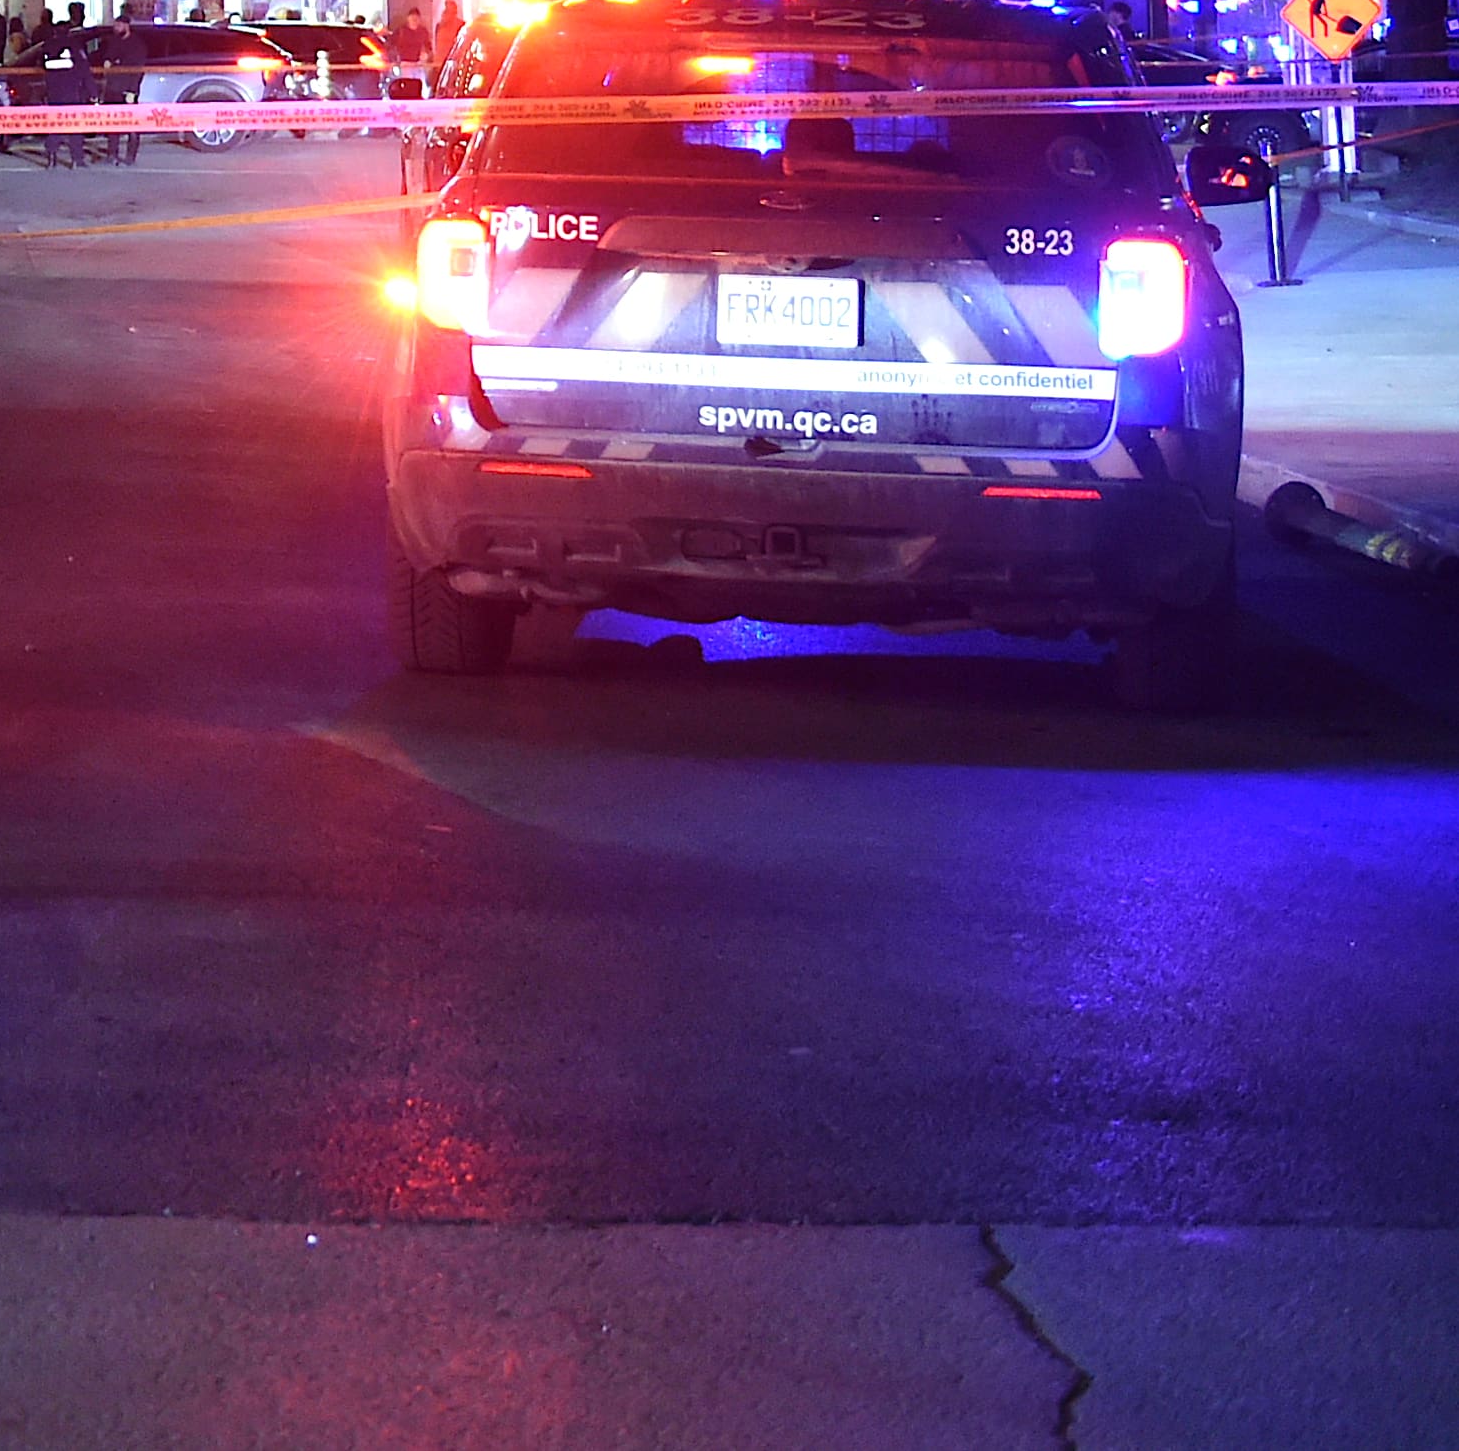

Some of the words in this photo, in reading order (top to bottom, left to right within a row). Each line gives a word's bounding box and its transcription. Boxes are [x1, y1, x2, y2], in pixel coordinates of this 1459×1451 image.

[664, 6, 927, 30] 38-23
[489, 211, 600, 241] POLICE
[1003, 227, 1076, 258] 38-23
[727, 293, 852, 328] FRK4002
[856, 368, 949, 387] anony
[954, 370, 973, 386] et
[978, 370, 1094, 390] confidentiel
[698, 402, 878, 438] spvm.qc.ca
